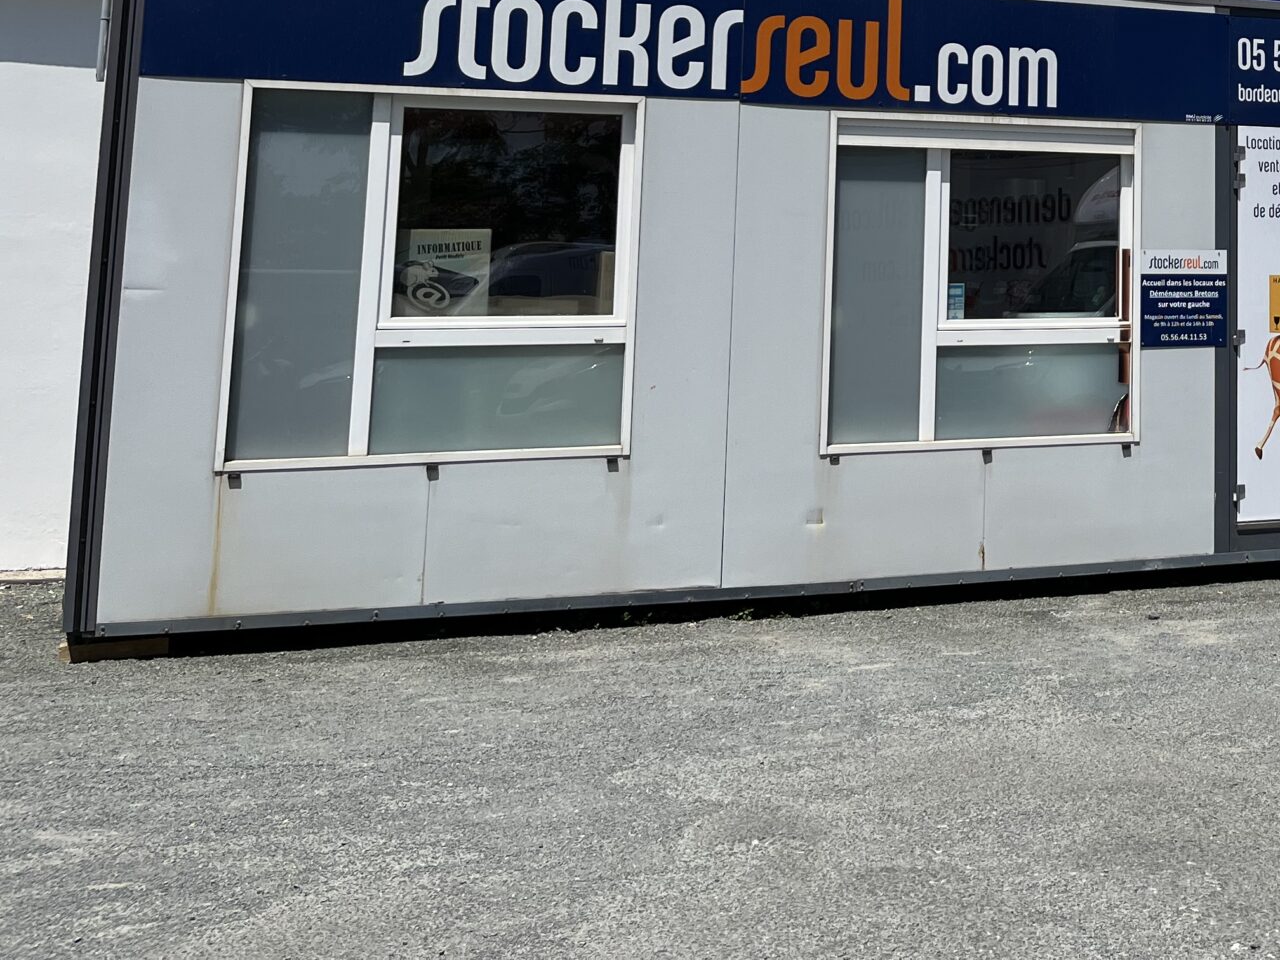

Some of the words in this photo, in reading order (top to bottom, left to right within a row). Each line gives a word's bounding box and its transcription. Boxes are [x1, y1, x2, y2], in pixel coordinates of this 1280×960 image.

[1237, 38, 1265, 71] 05
[1253, 203, 1266, 218] de
[417, 240, 482, 254] INFORMATIQUE
[1149, 255, 1218, 269] stockerseul.com
[1149, 290, 1193, 298] Déménageurs
[1194, 290, 1219, 298] Bretons
[1188, 301, 1210, 309] gauche
[1160, 333, 1208, 341] 05.56.44.11.53
